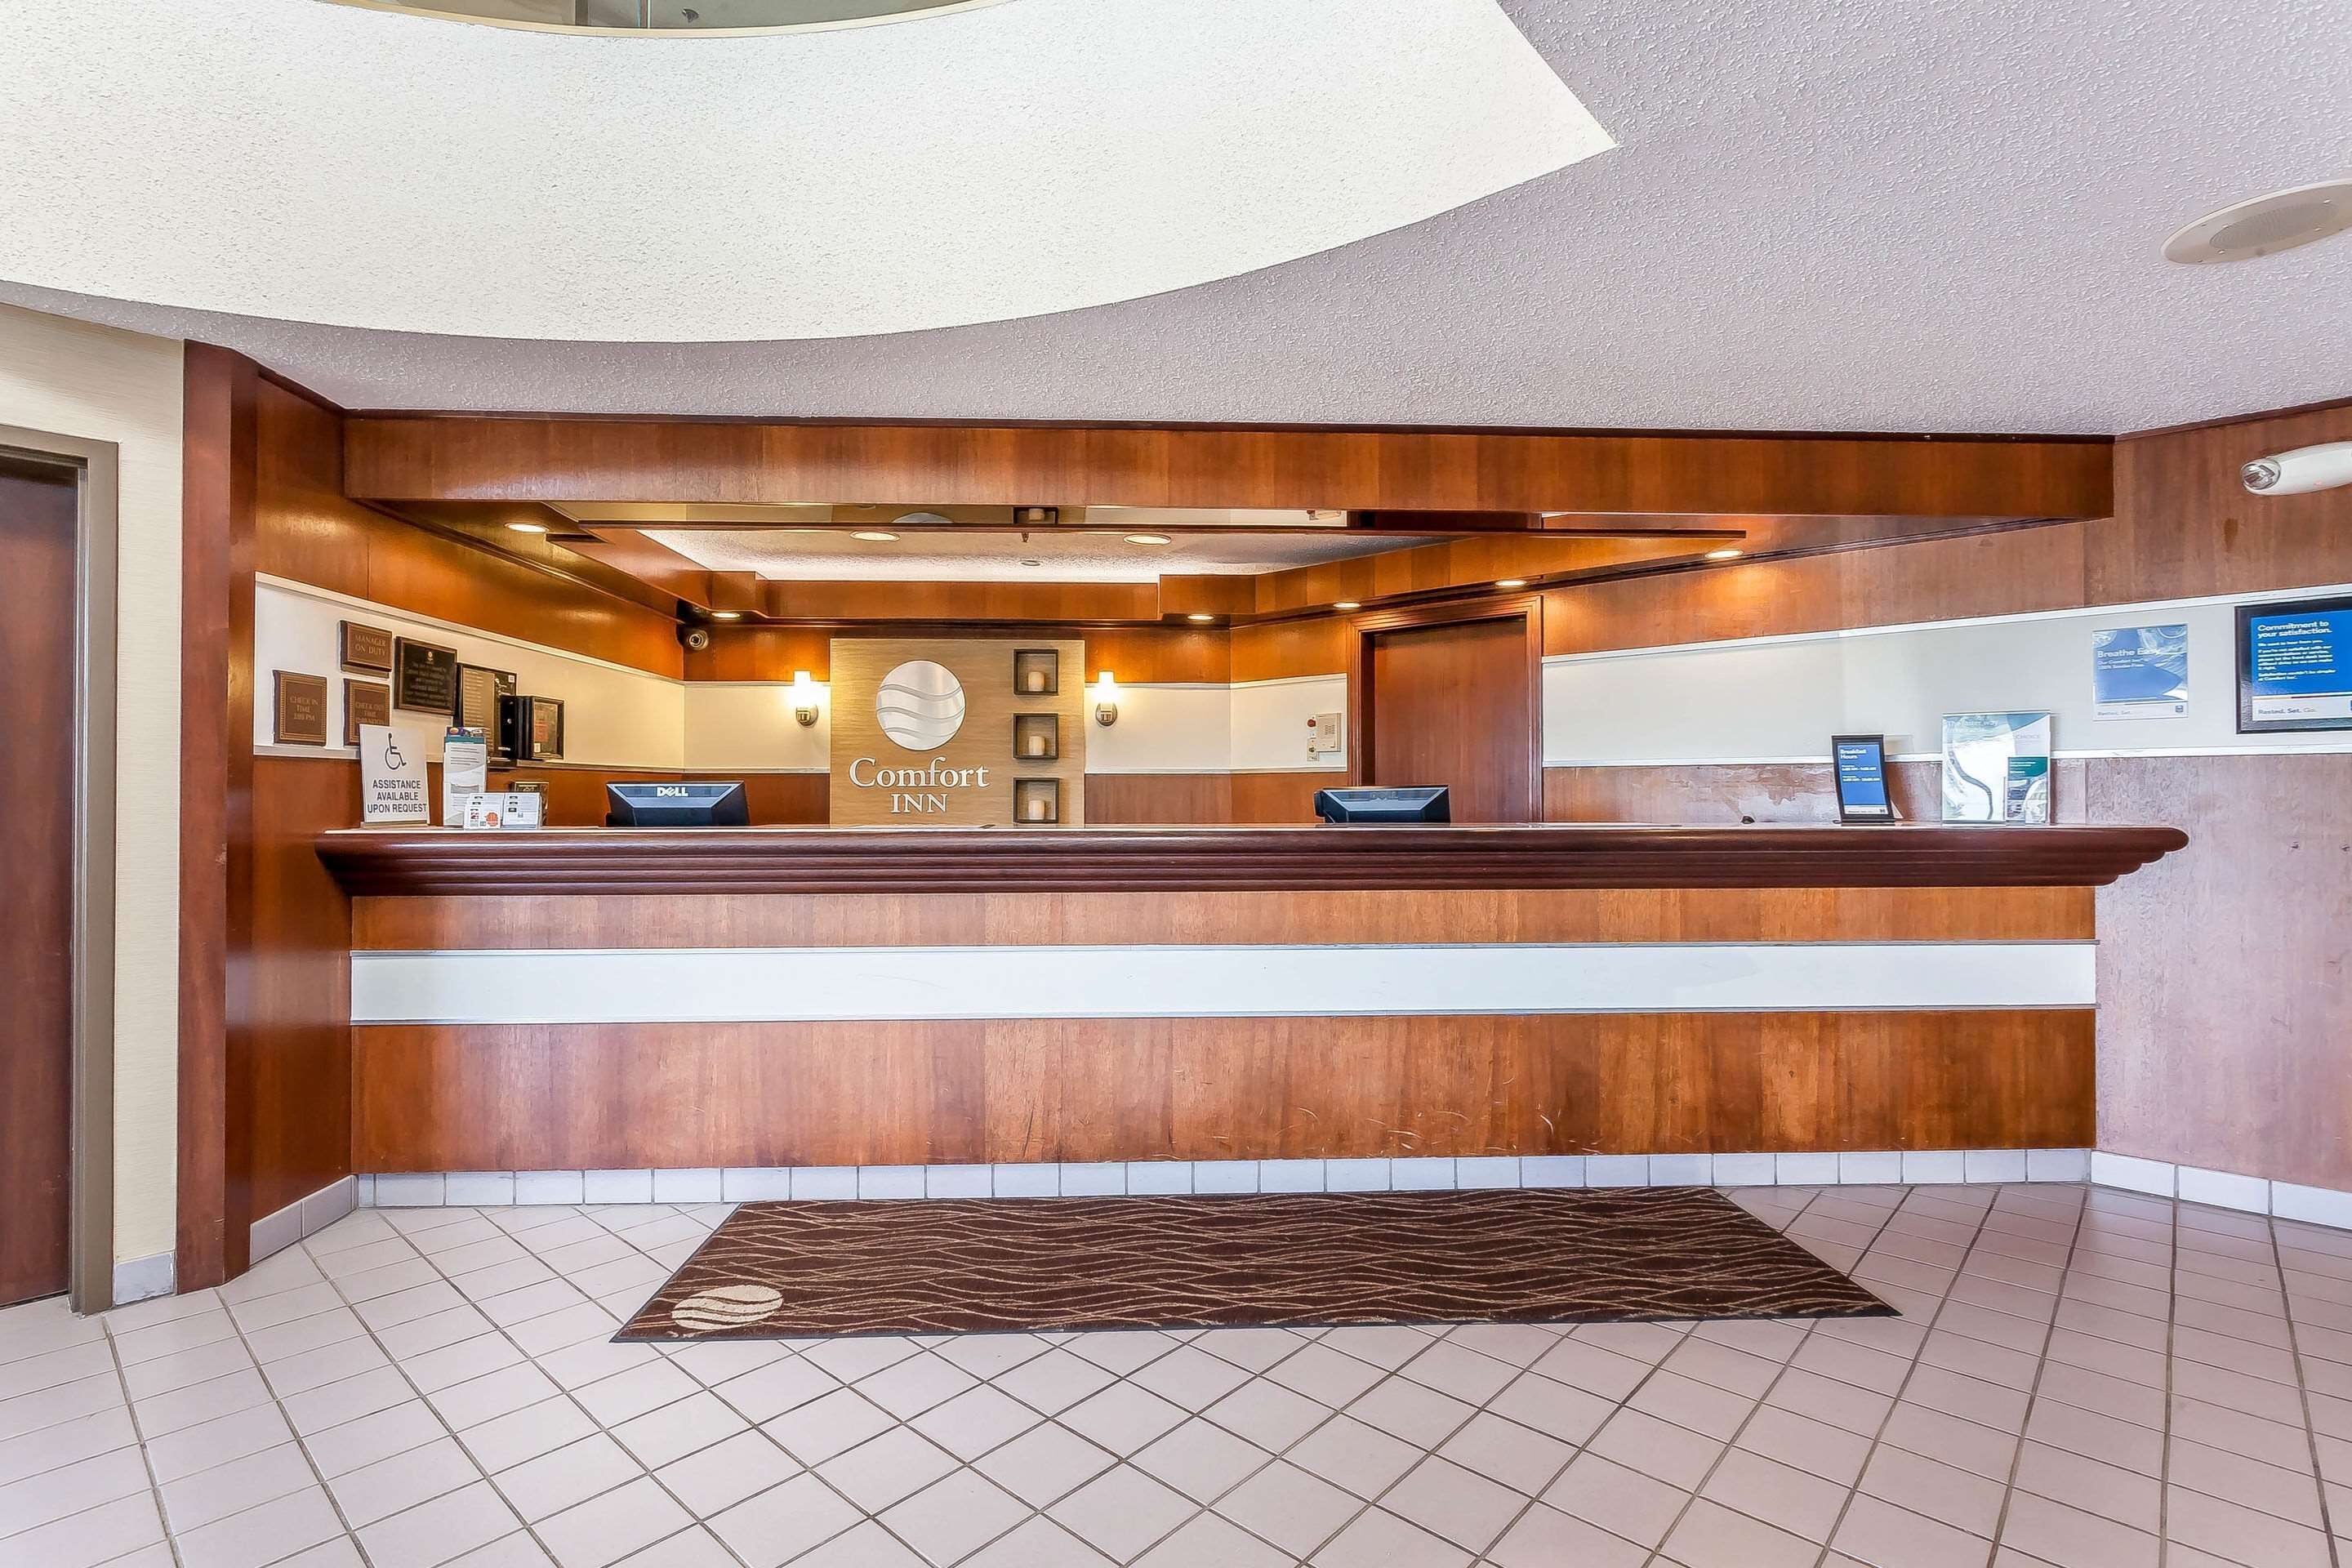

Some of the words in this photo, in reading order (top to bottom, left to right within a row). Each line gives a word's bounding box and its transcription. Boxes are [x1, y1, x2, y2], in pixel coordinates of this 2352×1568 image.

[2258, 621, 2318, 631] Commitment
[2278, 628, 2332, 637] satisfaction.
[355, 635, 386, 647] MANAGER
[354, 644, 366, 653] ON
[368, 645, 385, 656] DUTY
[2097, 649, 2135, 658] Breathe
[849, 756, 990, 787] Comfort
[372, 779, 421, 789] ASSISTANCE
[377, 792, 419, 800] AVAILABLE
[657, 786, 688, 797] DELL
[368, 804, 390, 813] UPON
[392, 803, 427, 813] REQUEST
[890, 793, 948, 813] INN
